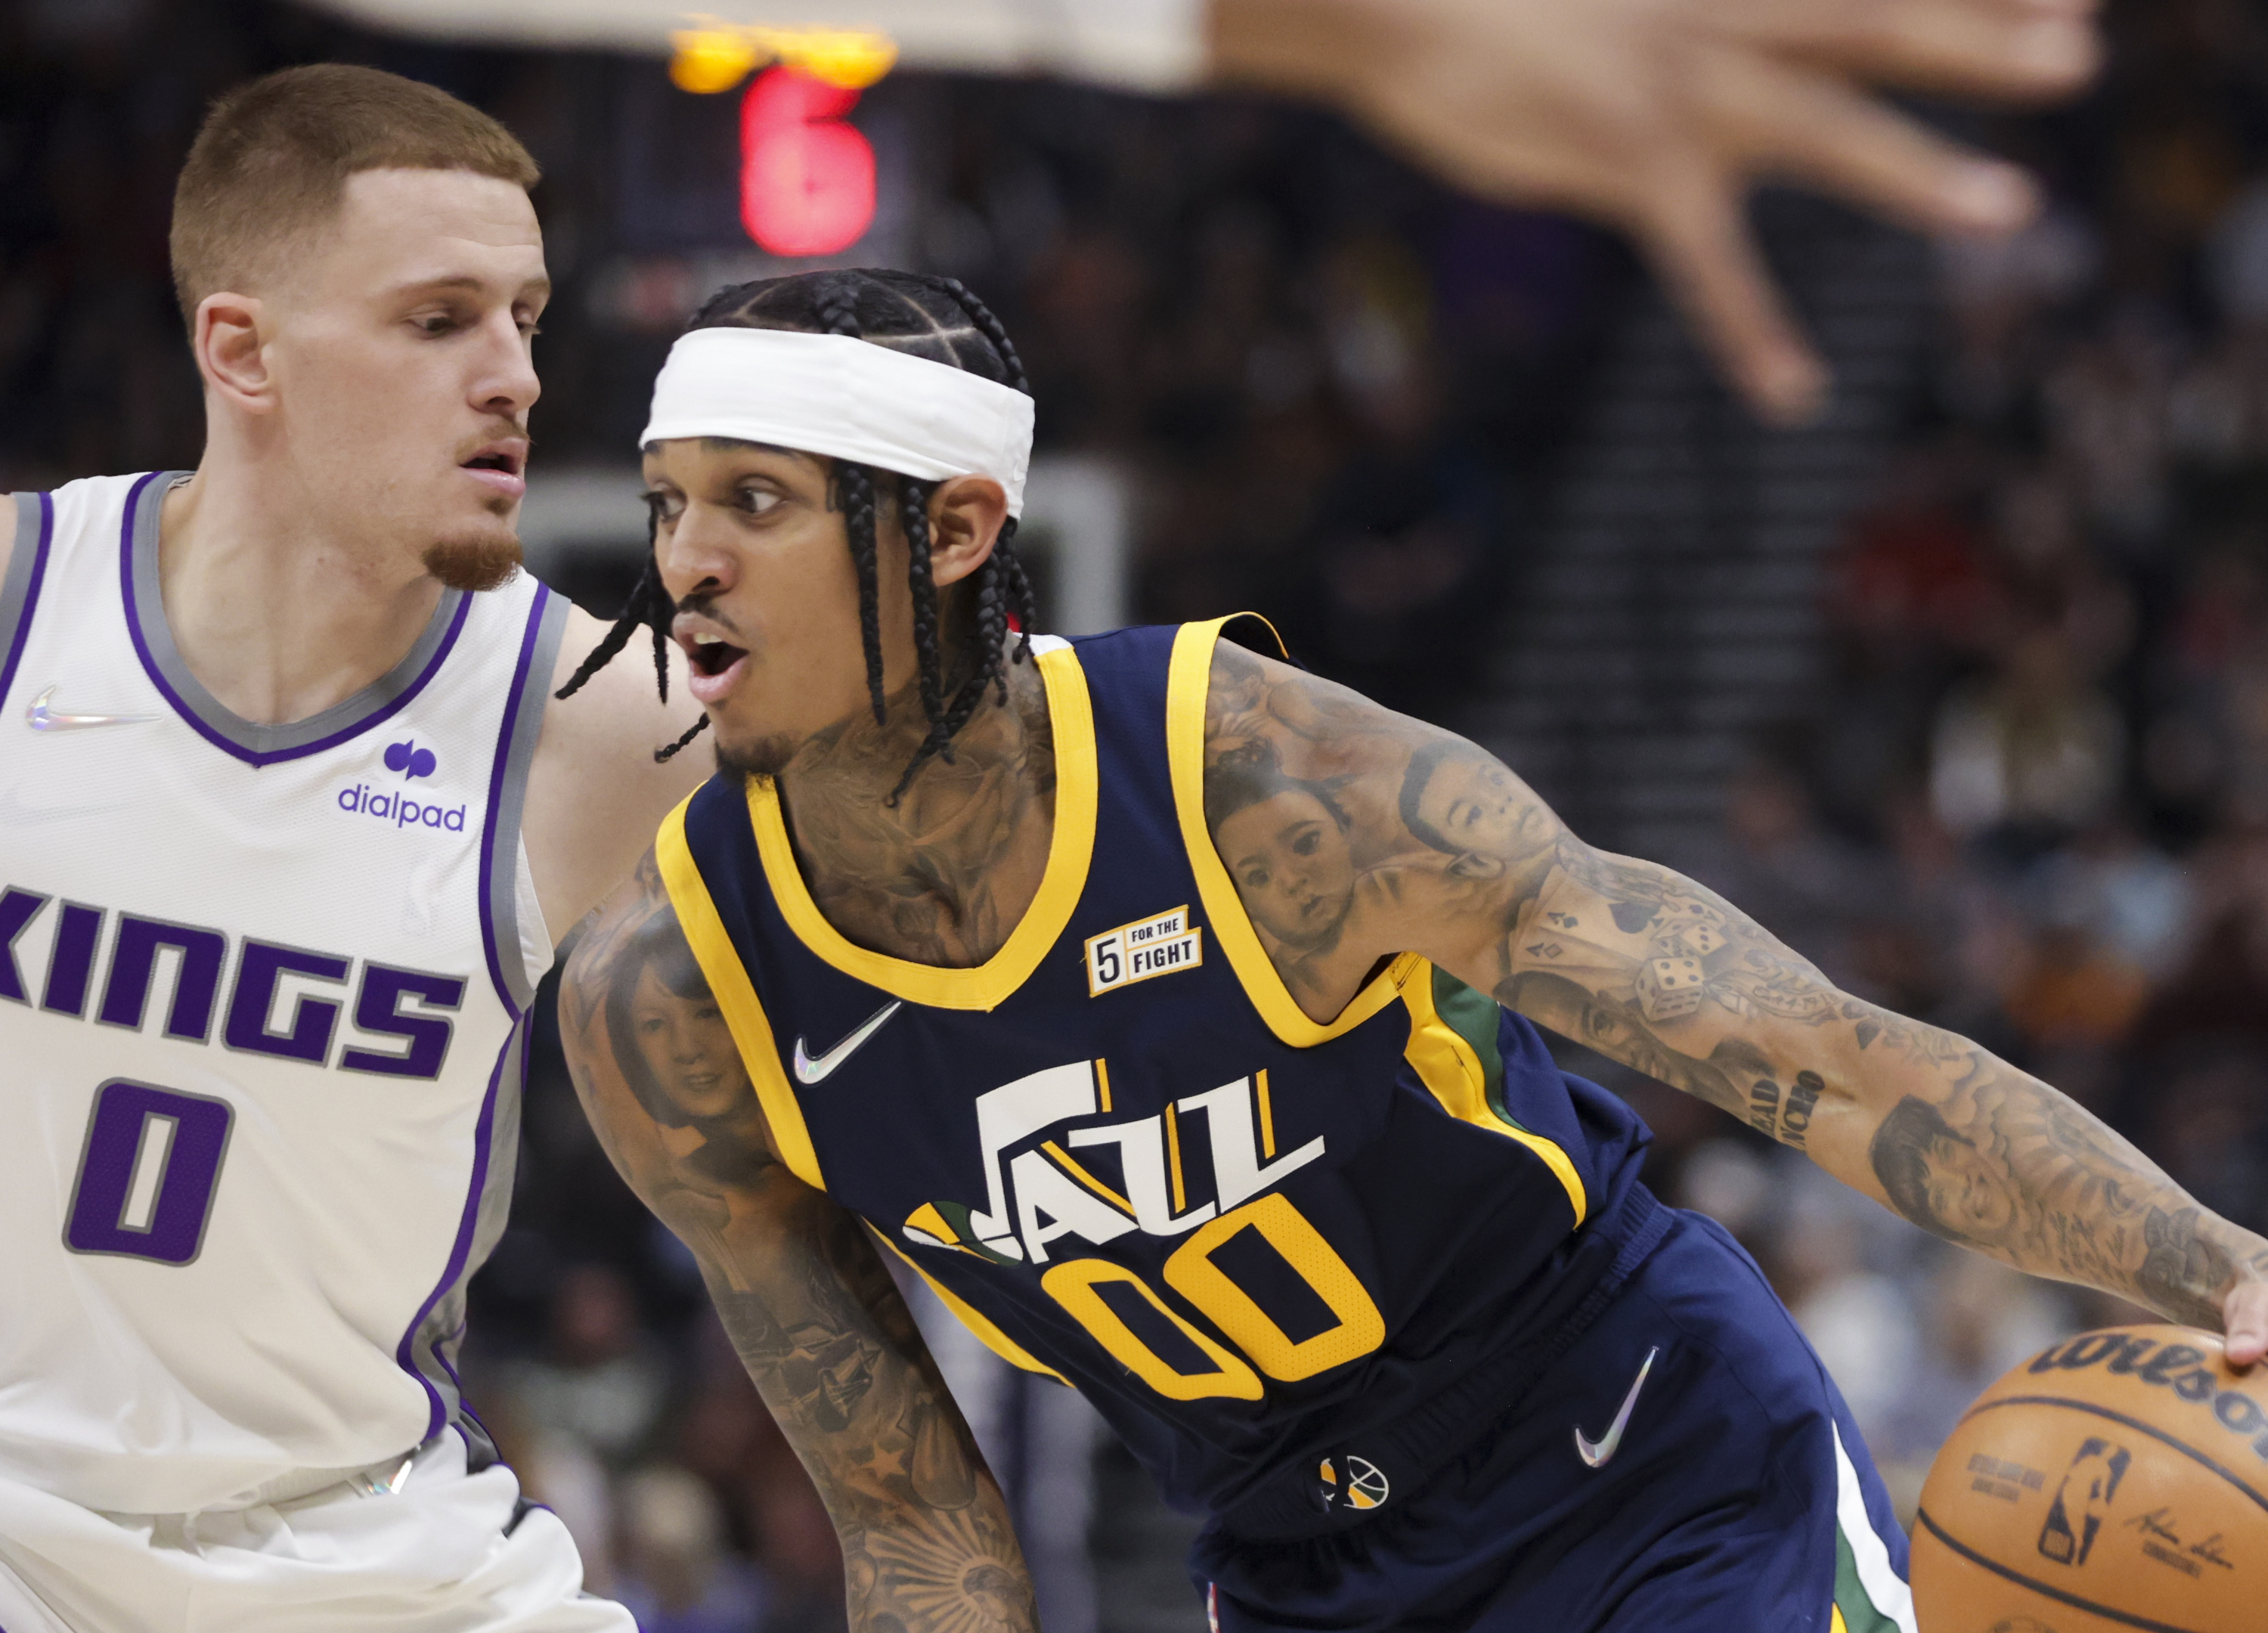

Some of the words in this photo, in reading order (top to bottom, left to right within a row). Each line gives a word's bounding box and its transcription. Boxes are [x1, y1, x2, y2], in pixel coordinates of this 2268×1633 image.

[338, 783, 466, 832] dialpad
[1131, 926, 1154, 943] FOR
[1157, 917, 1179, 935] THE
[1096, 937, 1120, 984] 5
[1133, 939, 1193, 974] FIGHT
[61, 1077, 236, 1268] 0
[903, 1058, 1325, 1266] JAZZ
[1040, 1191, 1387, 1401] 00
